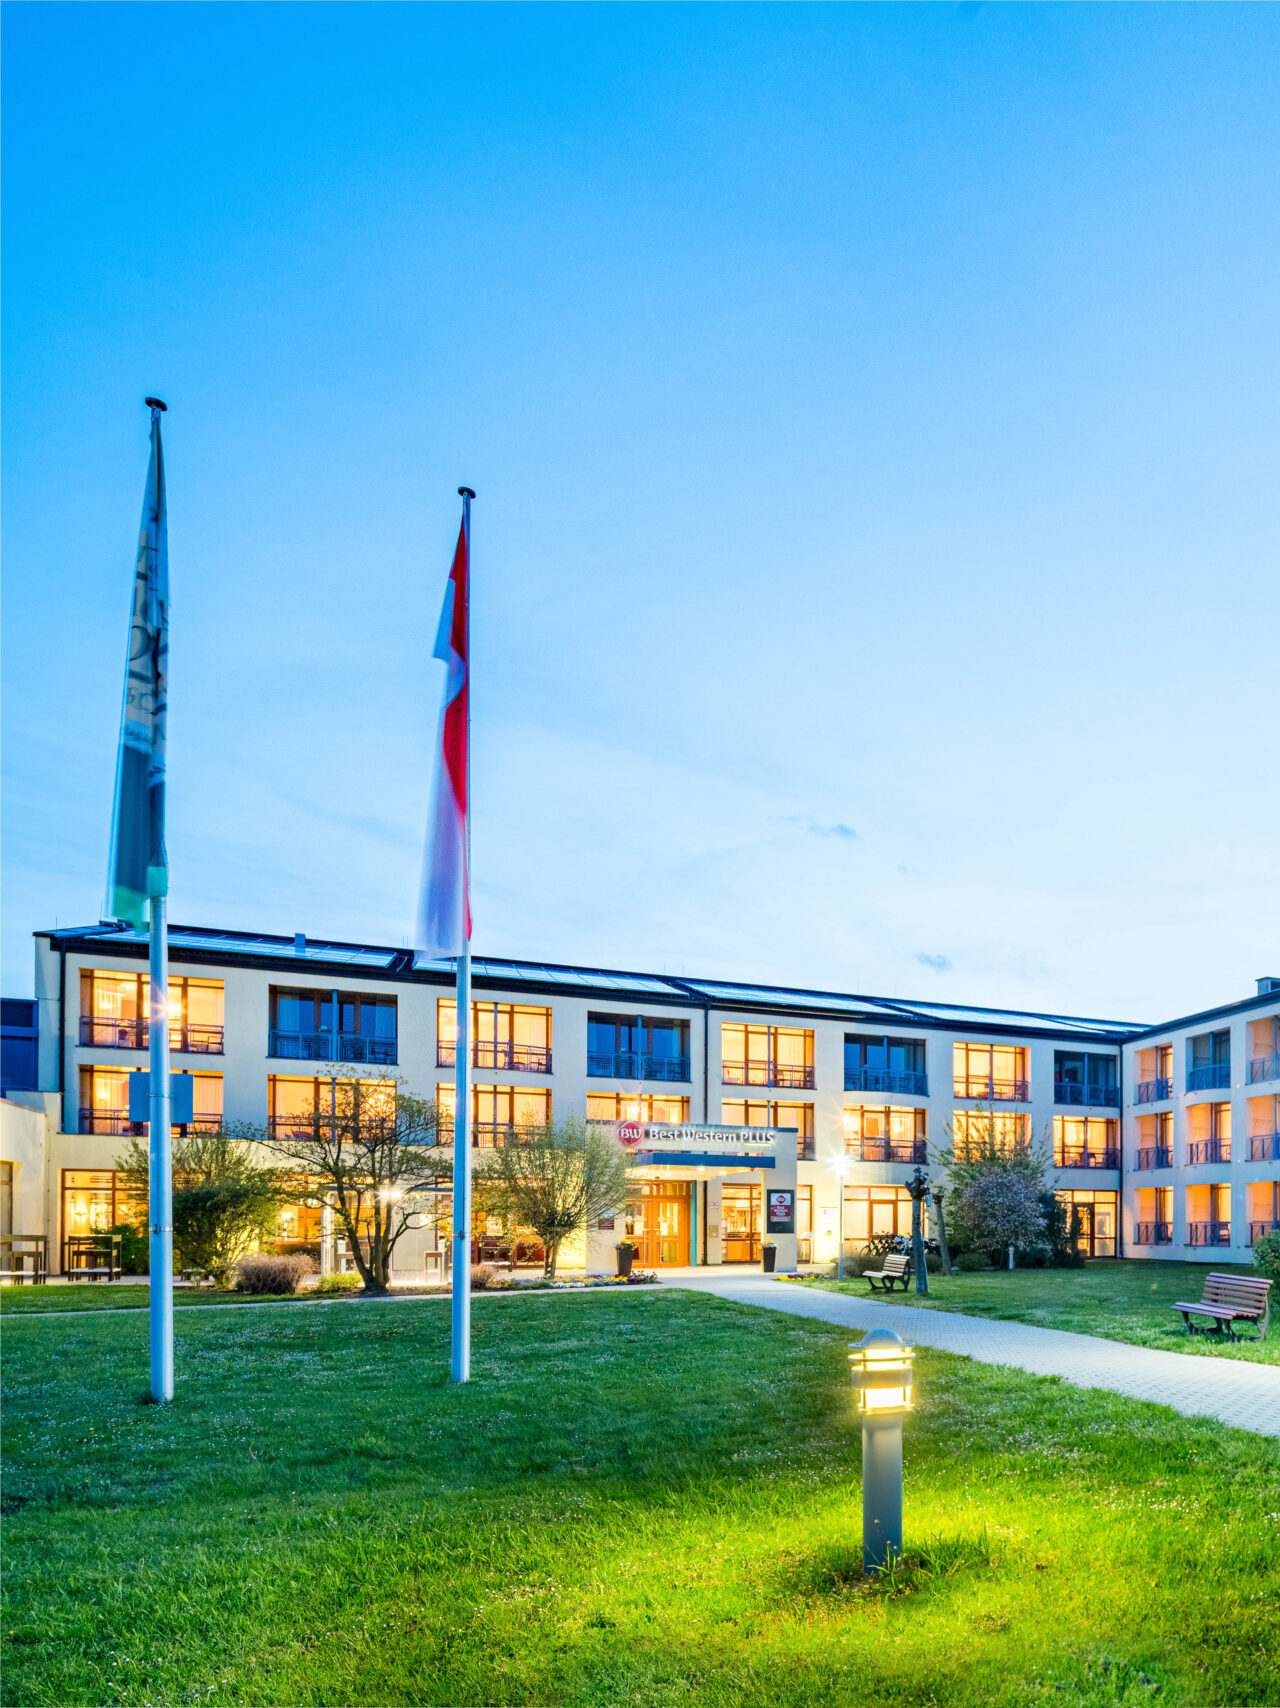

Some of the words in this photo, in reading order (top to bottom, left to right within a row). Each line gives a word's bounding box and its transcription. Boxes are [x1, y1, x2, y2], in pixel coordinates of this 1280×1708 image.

[620, 1127, 642, 1139] BW
[649, 1127, 681, 1141] Best
[682, 1129, 737, 1143] Western
[740, 1131, 775, 1144] PLUS
